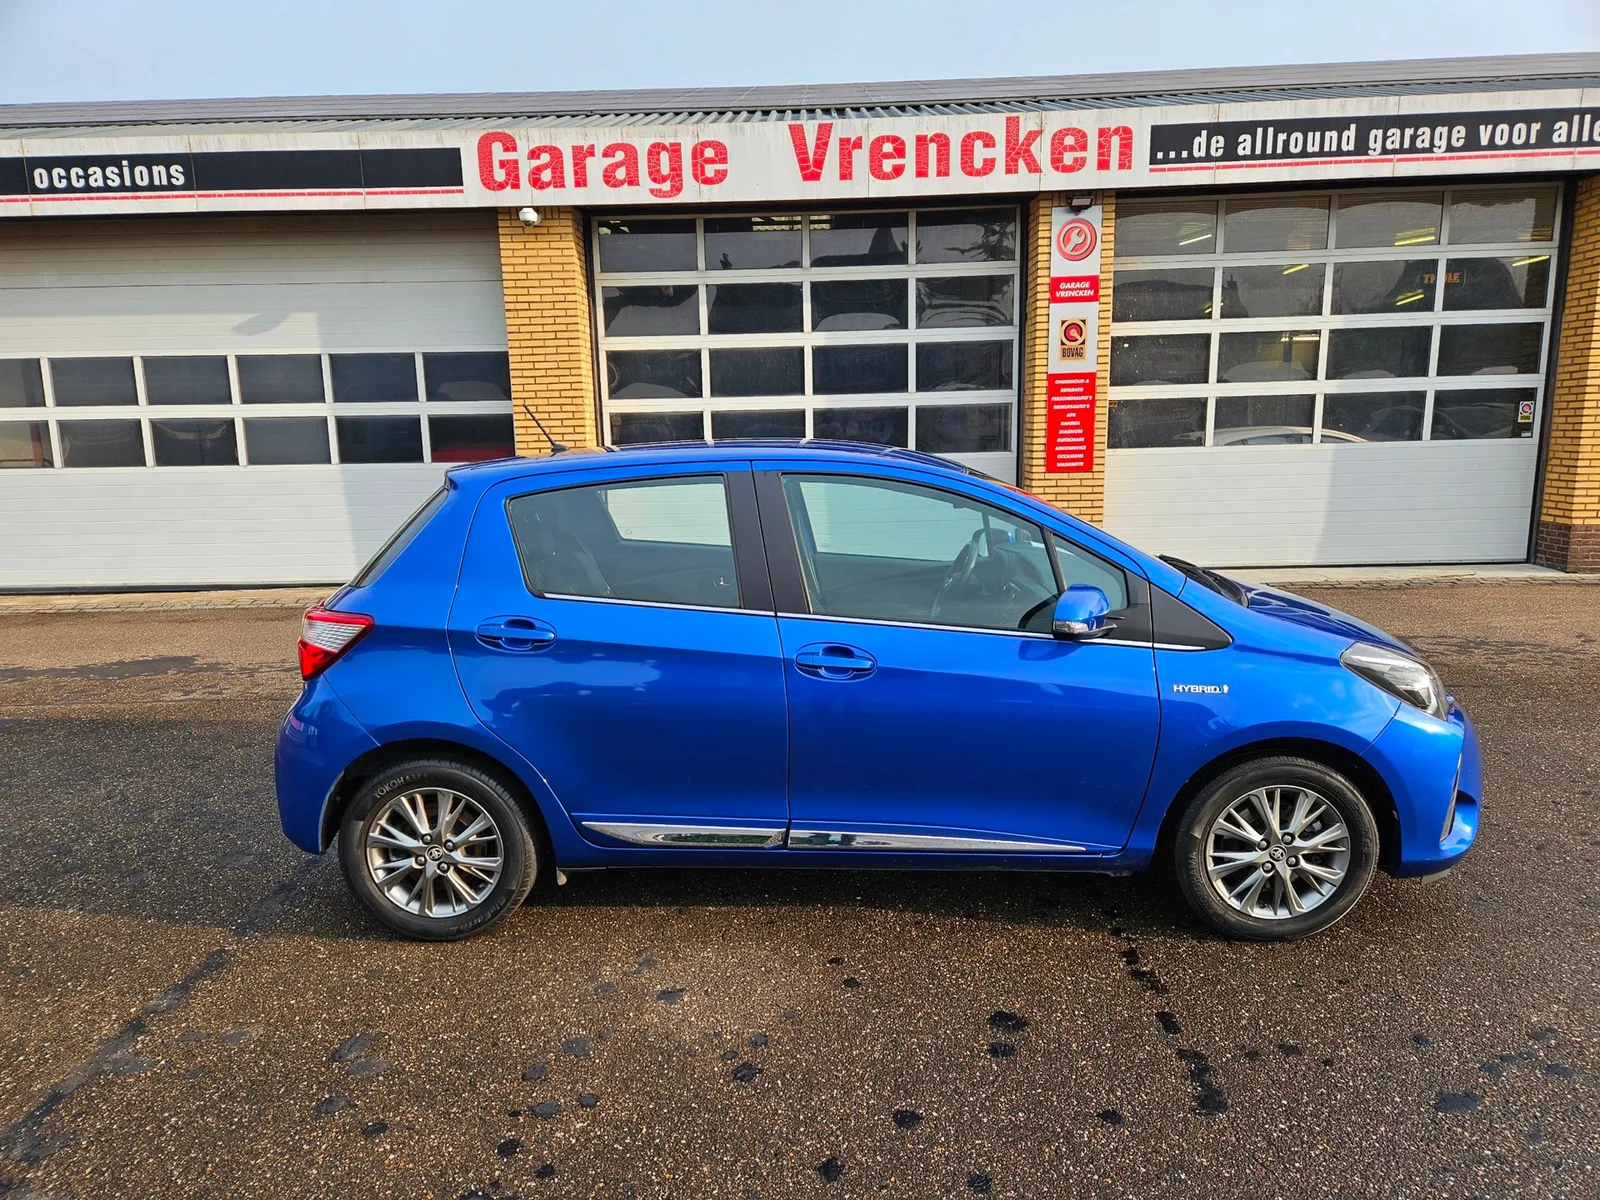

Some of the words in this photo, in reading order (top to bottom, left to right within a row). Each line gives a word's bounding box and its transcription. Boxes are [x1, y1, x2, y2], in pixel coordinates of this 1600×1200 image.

[1237, 124, 1356, 156] allround
[1368, 124, 1466, 156] garage
[1479, 122, 1541, 146] voor
[477, 131, 728, 198] Garage
[788, 115, 1134, 182] Vrencken
[33, 160, 185, 189] occasions
[1059, 281, 1091, 290] GARAGE
[1055, 289, 1094, 298] VRENCKEN
[1062, 347, 1084, 358] BOVAG
[1173, 684, 1221, 694] HYBRID
